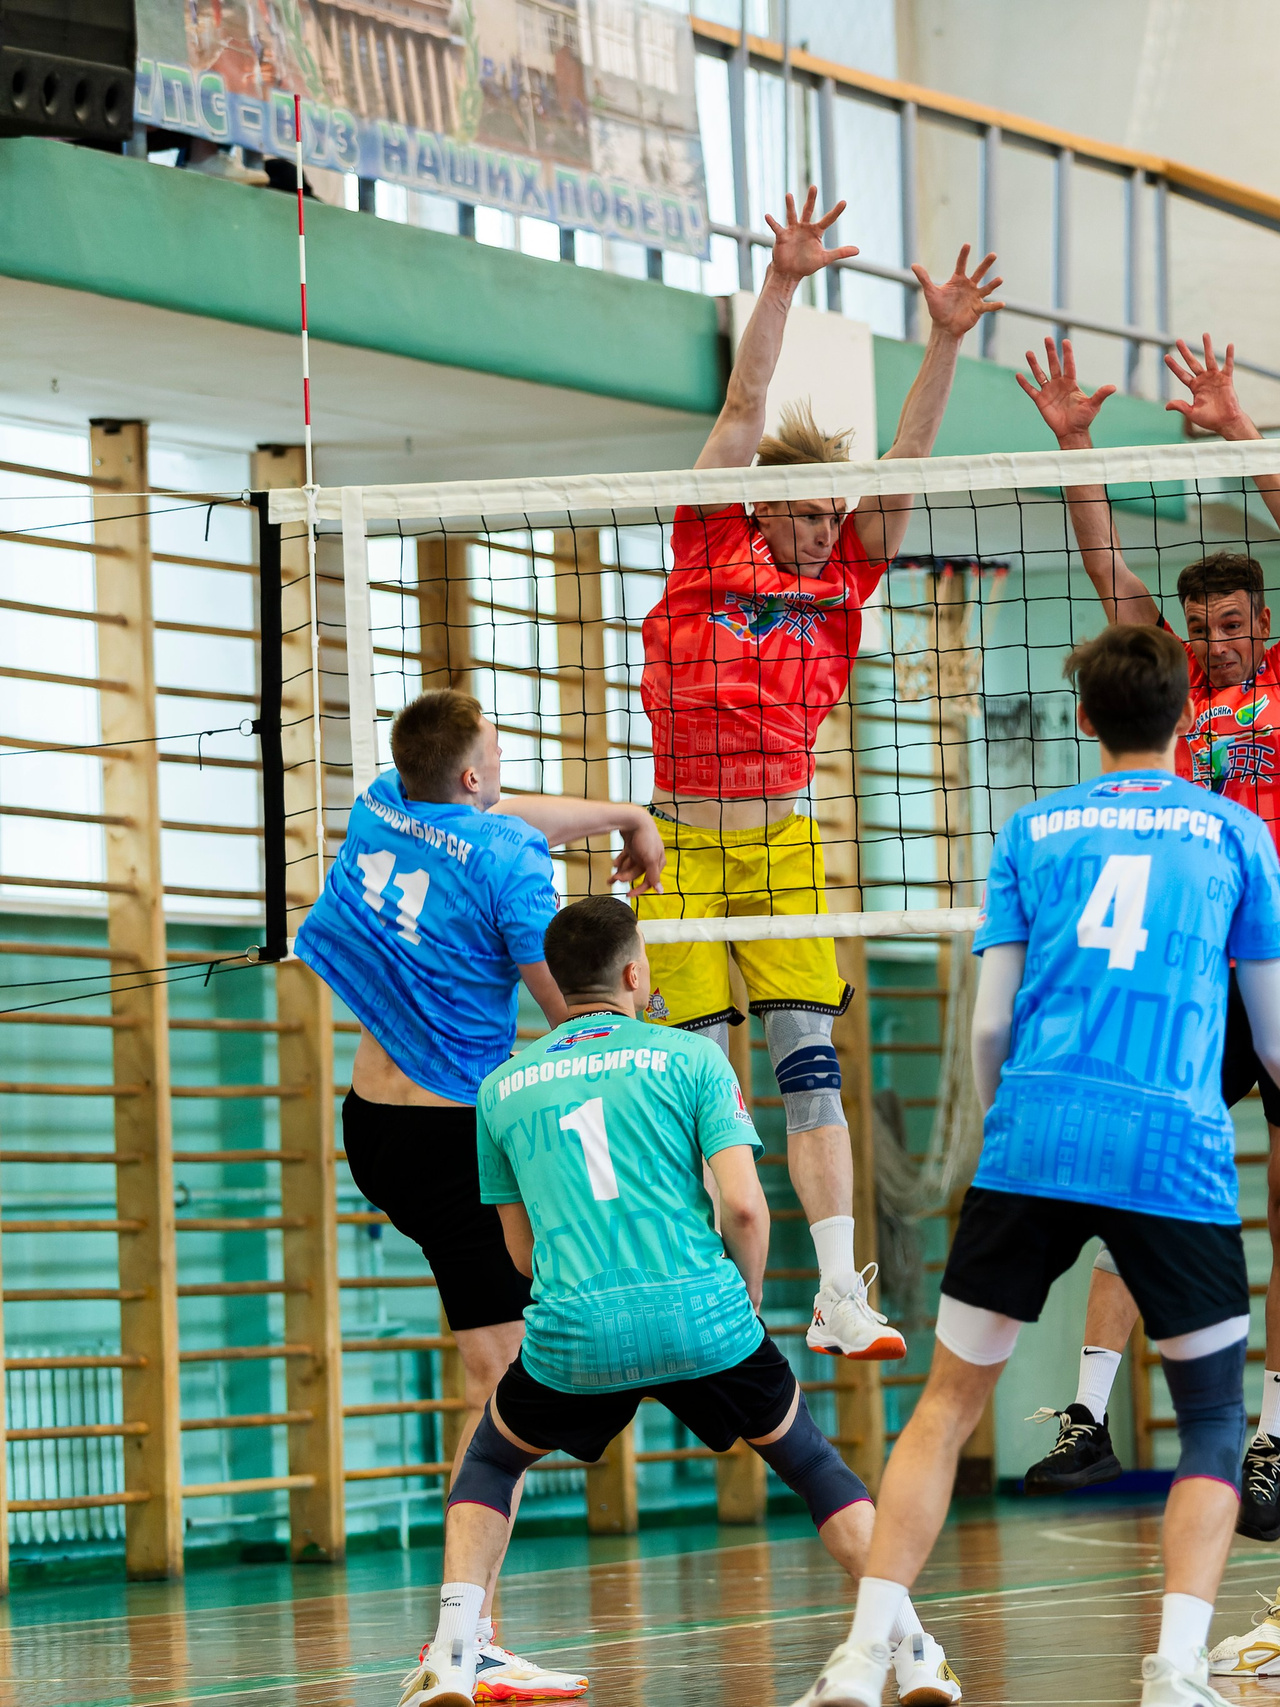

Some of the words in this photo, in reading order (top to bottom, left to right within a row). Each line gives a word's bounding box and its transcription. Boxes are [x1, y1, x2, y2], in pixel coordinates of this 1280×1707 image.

[270, 88, 359, 168] ВУЗ
[377, 120, 549, 212] НАШИХ
[361, 790, 473, 866] НОВОСИБИРСК
[1030, 806, 1223, 844] НОВОСИБИРСК
[357, 849, 430, 946] 11
[1077, 855, 1152, 971] 4
[1164, 930, 1228, 987] СГУП
[498, 1048, 669, 1101] НОВОСИБИРСК
[558, 1096, 620, 1201] 1
